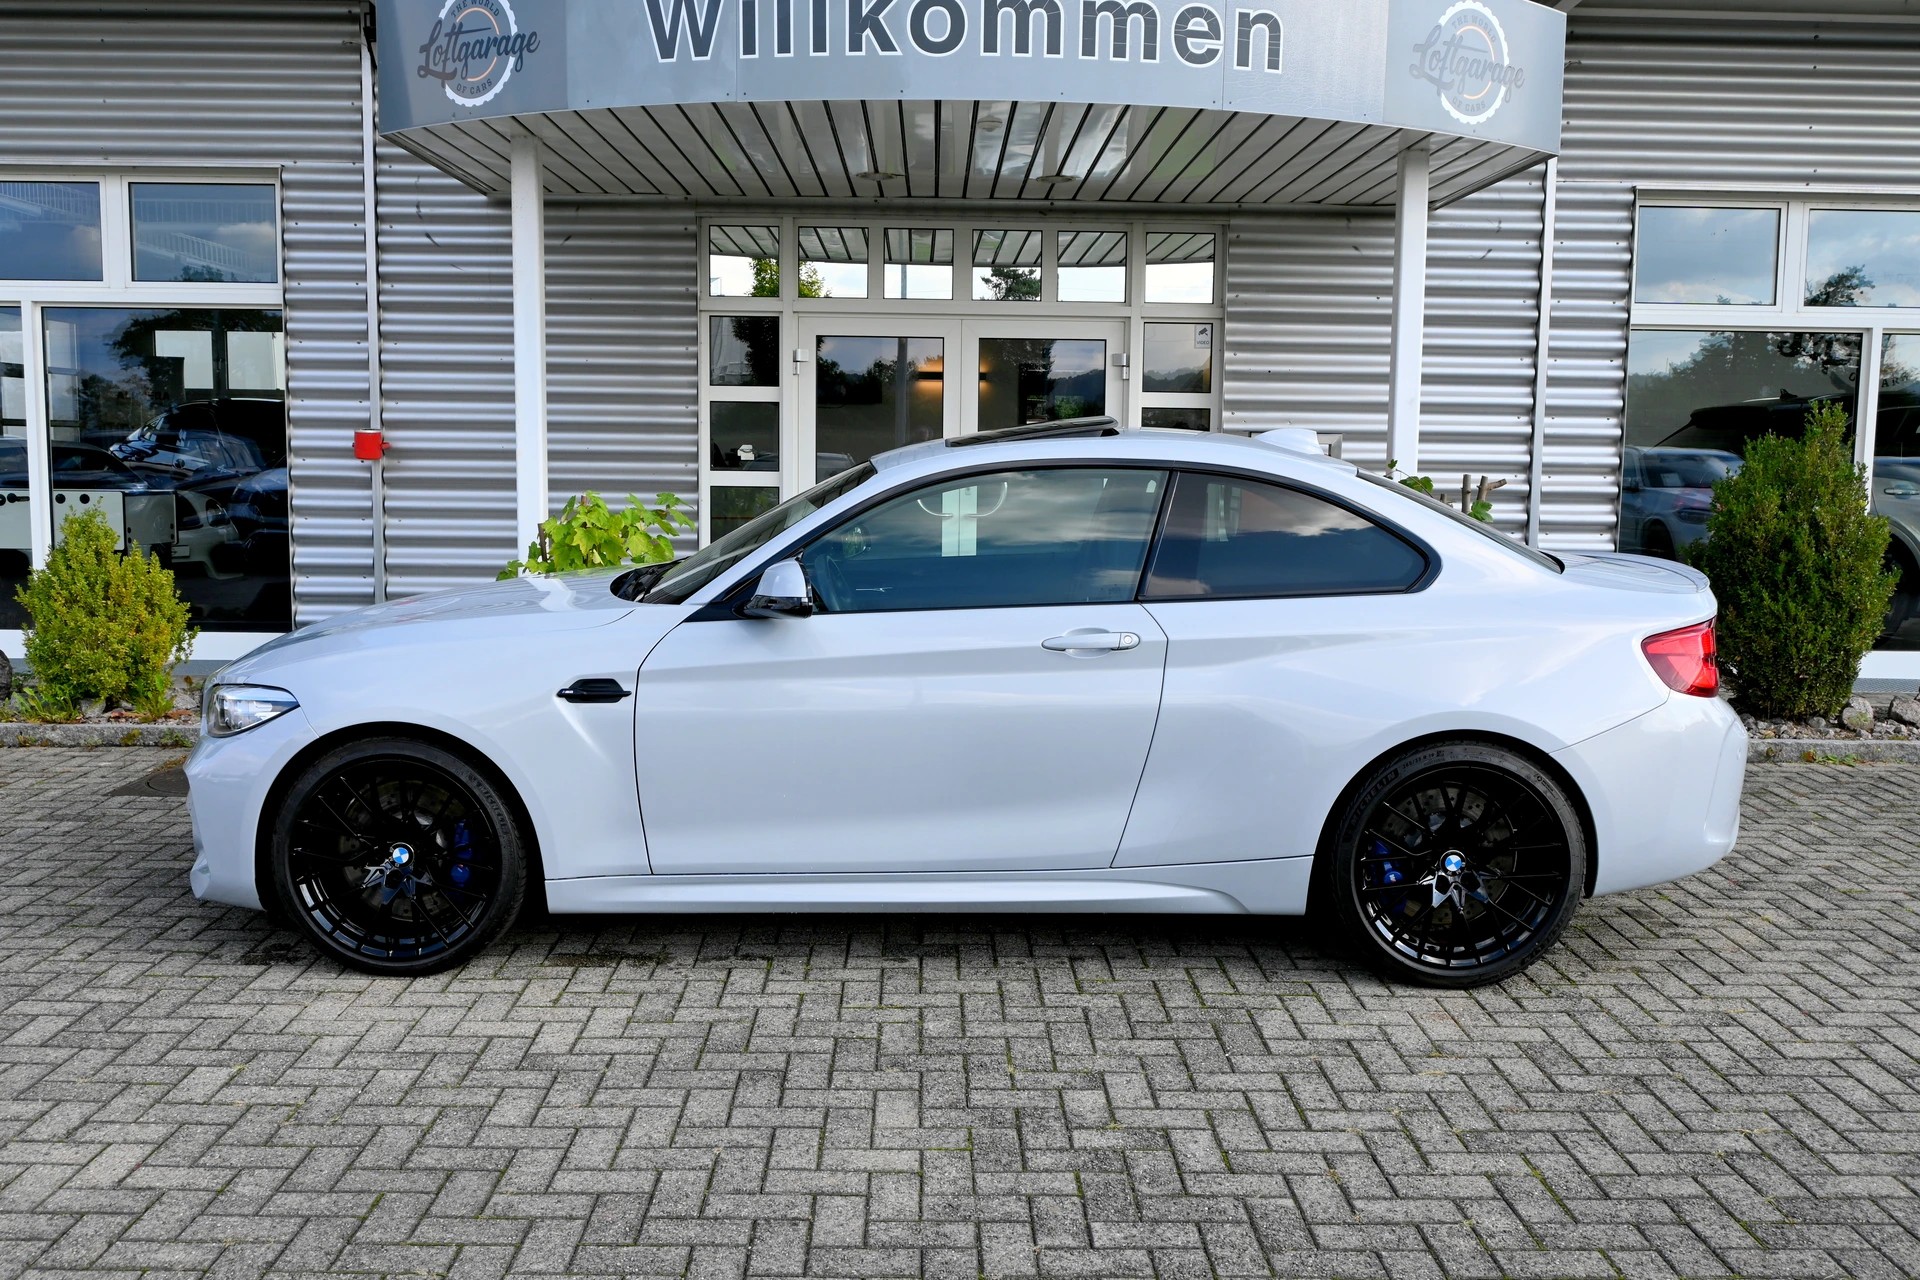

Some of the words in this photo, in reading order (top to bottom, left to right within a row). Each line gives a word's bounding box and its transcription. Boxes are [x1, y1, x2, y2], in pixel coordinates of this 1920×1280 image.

[451, 0, 468, 18] THE
[470, 0, 500, 17] WORLD
[1471, 15, 1497, 43] WORLD
[417, 19, 540, 89] Loftgarage
[643, 0, 1283, 74] Willkommen
[1409, 24, 1525, 103] Loftgarage
[456, 83, 466, 94] OF
[469, 79, 493, 95] CARS
[1465, 100, 1486, 112] CARS
[1350, 771, 1398, 827] MICHELIN
